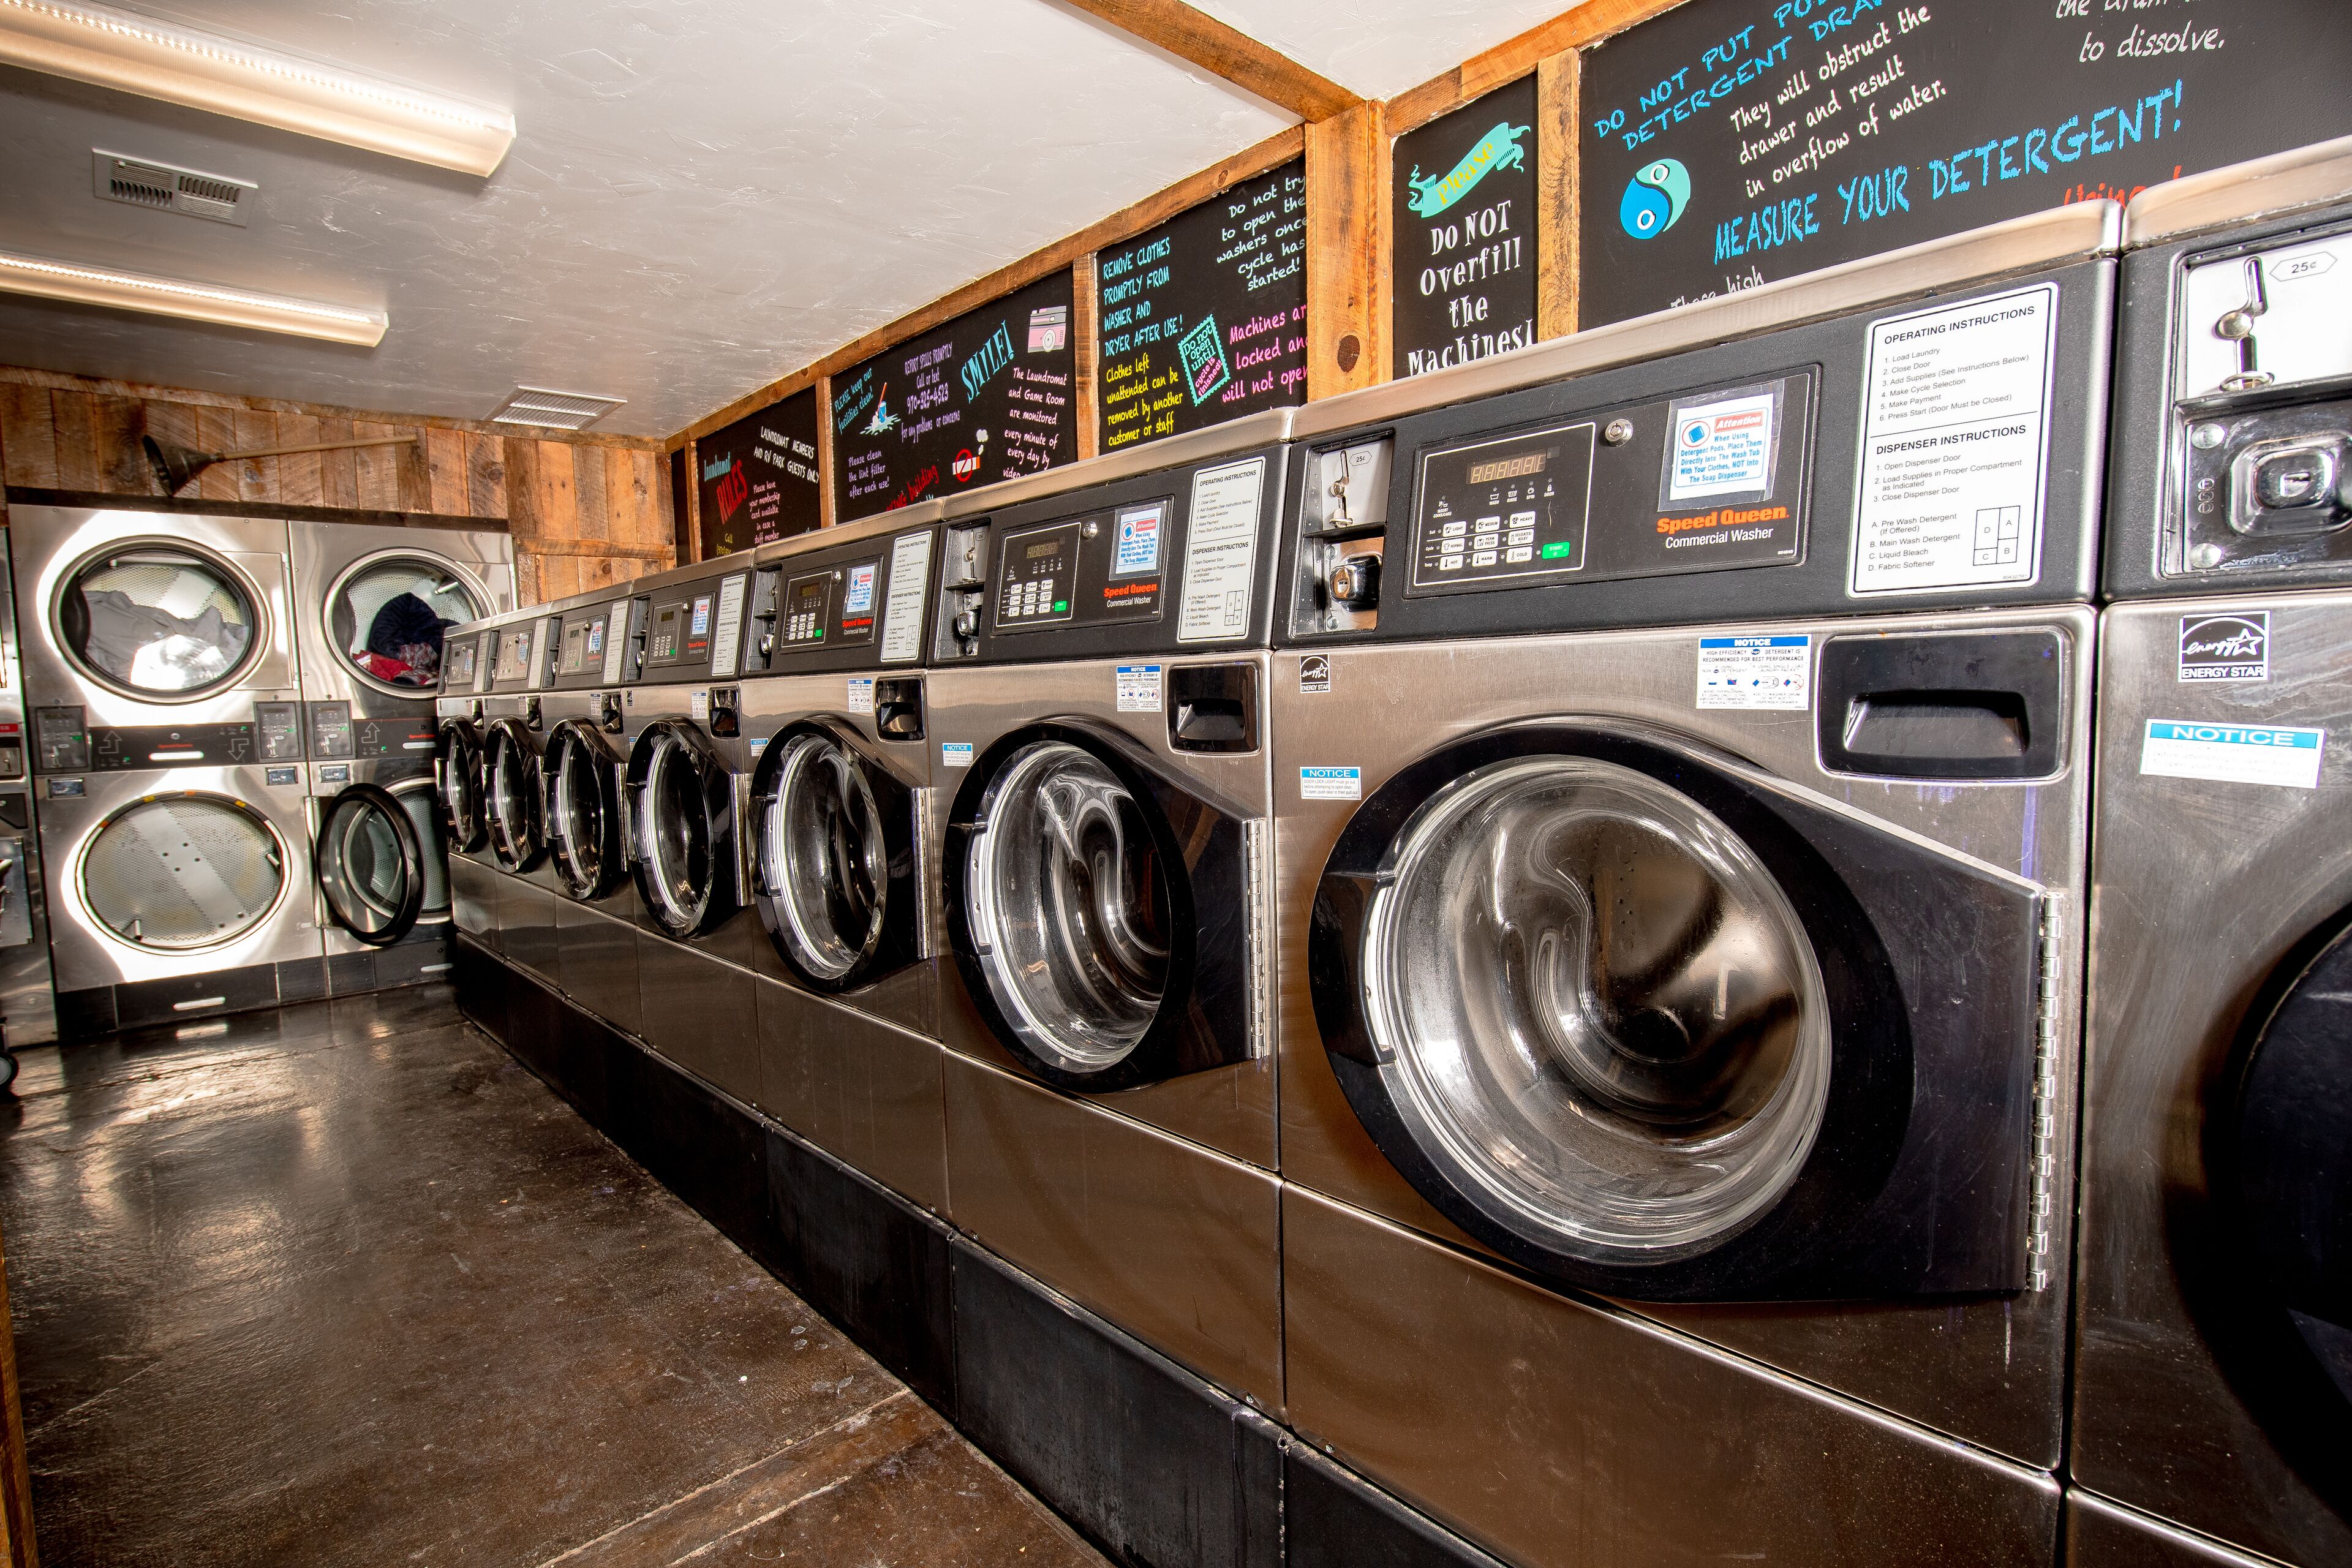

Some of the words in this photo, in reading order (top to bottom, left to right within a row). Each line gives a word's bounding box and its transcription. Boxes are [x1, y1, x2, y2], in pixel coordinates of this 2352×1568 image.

[2079, 31, 2105, 62] to
[2117, 20, 2225, 57] dissolve.
[1594, 109, 1626, 137] DO
[1640, 67, 1689, 113] NOT
[1702, 24, 1755, 72] PUT
[1773, 0, 1826, 28] PO
[1622, 36, 1793, 151] DETERGENT
[1809, 0, 1882, 41] DRA
[1730, 101, 1771, 132] They
[1777, 70, 1810, 105] will
[1818, 22, 1892, 81] obstruct
[1898, 6, 1931, 34] the
[1740, 119, 1796, 165] drawer
[1806, 91, 1841, 126] and
[1850, 55, 1905, 103] result
[1745, 178, 1765, 198] in
[1773, 132, 1850, 185] overflow
[1858, 103, 1879, 137] of
[1890, 80, 1947, 120] water.
[1436, 141, 1495, 206] Please
[1714, 192, 1820, 265] MEASURE
[1838, 165, 1910, 225] YOUR
[1929, 78, 2184, 201] DETERGENT!
[1229, 203, 1245, 218] Do
[1253, 183, 1277, 206] not
[1285, 175, 1306, 194] try
[1222, 228, 1235, 242] to
[1243, 208, 1276, 236] open
[1284, 197, 1306, 213] the
[1430, 225, 1458, 256] DO
[1464, 200, 1512, 247] NOT
[1216, 233, 1267, 264] washers
[1275, 216, 1308, 238] once
[1104, 251, 1133, 280] REMOVE
[1137, 236, 1170, 266] CLOTHES
[1238, 251, 1273, 279] cycle
[1281, 238, 1305, 257] has
[1248, 257, 1300, 292] started!
[1420, 236, 1521, 296] Overfill
[1104, 274, 1143, 306] PROMPTLY
[1147, 266, 1169, 289] FROM
[1104, 308, 1132, 332] WASHER
[1136, 301, 1150, 320] AND
[1230, 311, 1285, 345] Machines
[1292, 304, 1306, 321] ar
[1449, 295, 1488, 329] the
[1885, 325, 1946, 345] OPERATING
[1950, 306, 2035, 331] INSTRUCTIONS
[1106, 334, 1130, 357] DRYER
[1134, 323, 1160, 347] AFTER
[1183, 340, 1196, 355] Do
[1197, 325, 1212, 344] not
[1191, 338, 1211, 360] open
[1236, 337, 1281, 371] locked
[1288, 336, 1308, 353] an
[1893, 352, 1910, 363] Load
[1912, 347, 1940, 359] Laundry
[961, 320, 1014, 404] SMILE!
[1106, 363, 1132, 383] Clothes
[1136, 353, 1149, 374] left
[1191, 345, 1216, 371] until
[1195, 365, 1210, 388] cycle
[1208, 356, 1215, 366] is
[1891, 364, 1912, 374] Close
[1913, 360, 1931, 370] Door
[1013, 367, 1024, 380] The
[1026, 369, 1066, 386] Laundromat
[1107, 376, 1148, 404] unattended
[1152, 375, 1166, 389] can
[1169, 366, 1178, 383] be
[1198, 360, 1223, 397] finished!
[1222, 379, 1245, 404] will
[1252, 371, 1273, 394] not
[1890, 388, 1908, 397] Make
[1910, 384, 1931, 396] Cycle
[1933, 377, 1966, 390] Selection
[907, 382, 949, 415] 970-325-4523
[1008, 387, 1021, 399] and
[1024, 389, 1042, 402] Game
[1046, 392, 1065, 406] Room
[1108, 404, 1138, 426] removed
[1142, 401, 1150, 422] by
[1154, 392, 1183, 411] another
[1009, 408, 1020, 418] are
[1022, 410, 1057, 425] monitored
[1109, 428, 1139, 446] customer
[1144, 424, 1152, 435] or
[1156, 411, 1174, 434] staff
[1716, 415, 1762, 429] Attention
[761, 426, 790, 448] LAUNDROMAT
[792, 440, 814, 460] MEMBERS
[1005, 429, 1021, 446] every
[1024, 431, 1046, 445] minute
[1049, 434, 1058, 450] of
[1877, 439, 1937, 454] DISPENSER
[1940, 424, 2026, 446] INSTRUCTIONS
[754, 446, 763, 459] AND
[764, 450, 771, 463] RV
[772, 453, 784, 469] PARK
[787, 460, 805, 479] GUESTS
[807, 467, 820, 483] ONLY
[848, 454, 865, 467] Please
[867, 450, 881, 461] clean
[859, 467, 868, 480] lint
[871, 464, 886, 476] filter
[1008, 447, 1024, 464] every
[1027, 453, 1039, 469] day
[1042, 450, 1050, 470] by
[716, 459, 747, 525] RULES
[850, 484, 862, 499] after
[864, 482, 876, 492] each
[878, 475, 889, 489] use!
[1657, 512, 1717, 535] Speed
[1720, 506, 1787, 526] Queen
[1665, 531, 1728, 549] Commercial
[1731, 527, 1774, 543] Washer
[1879, 550, 1901, 560] Liquid
[1903, 548, 1928, 557] Bleach
[1104, 586, 1129, 598] Speed
[1131, 583, 1157, 594] Queen
[1107, 598, 1133, 608] Commercial
[1134, 596, 1152, 605] Washer
[2182, 667, 2229, 678] ENERGY
[2230, 666, 2264, 677] STAR
[2172, 726, 2294, 745] NOTICE
